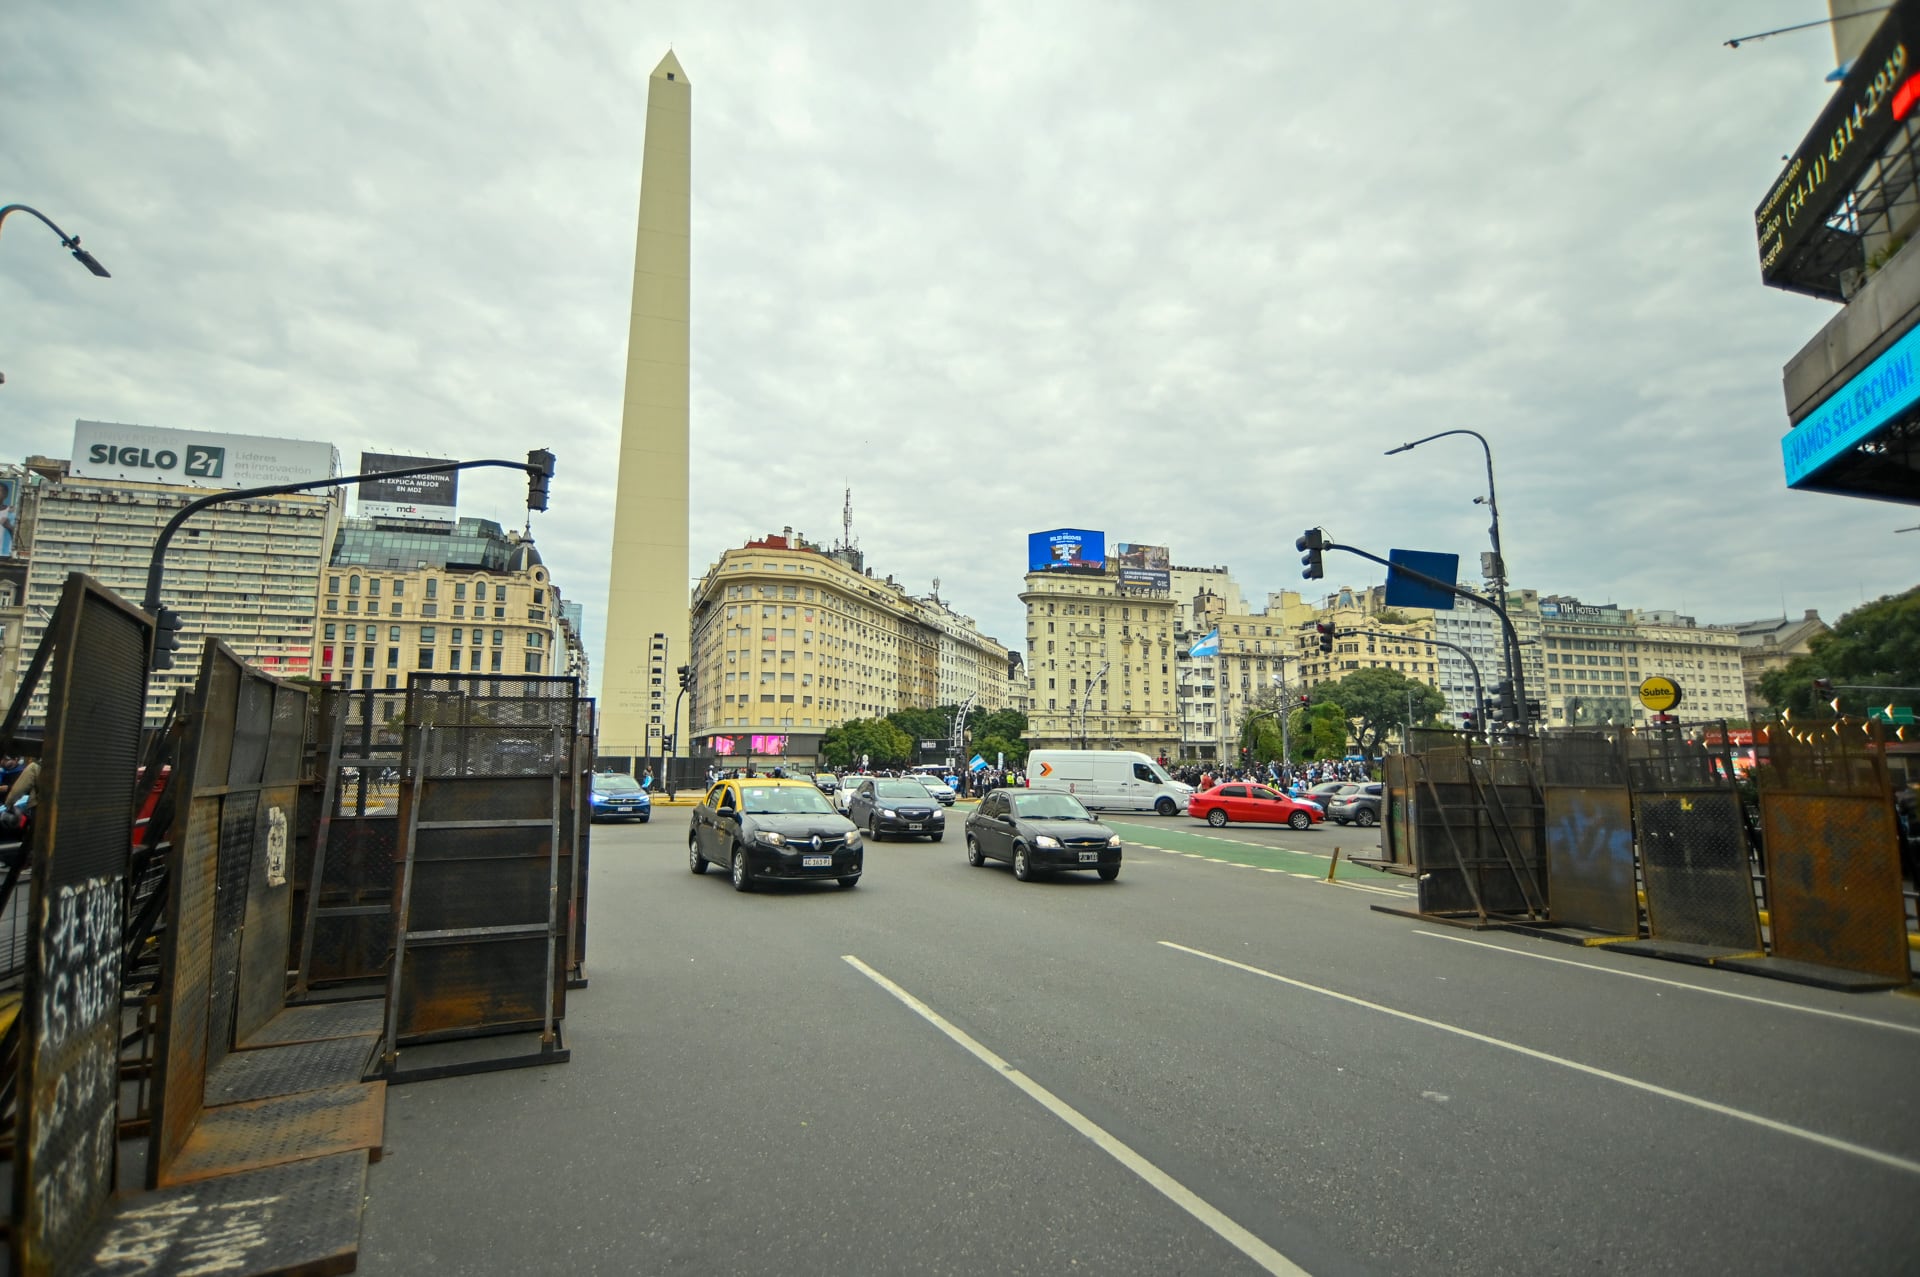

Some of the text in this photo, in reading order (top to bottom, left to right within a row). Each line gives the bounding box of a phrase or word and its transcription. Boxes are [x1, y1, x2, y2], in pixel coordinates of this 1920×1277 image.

[1786, 154, 1827, 227] (54-11)
[89, 443, 218, 476] SIGLO 21
[234, 462, 248, 470] en
[416, 480, 439, 488] MEJOR
[396, 504, 417, 513] mdz
[1576, 606, 1600, 615] HOTELS
[1643, 688, 1671, 697] Subte
